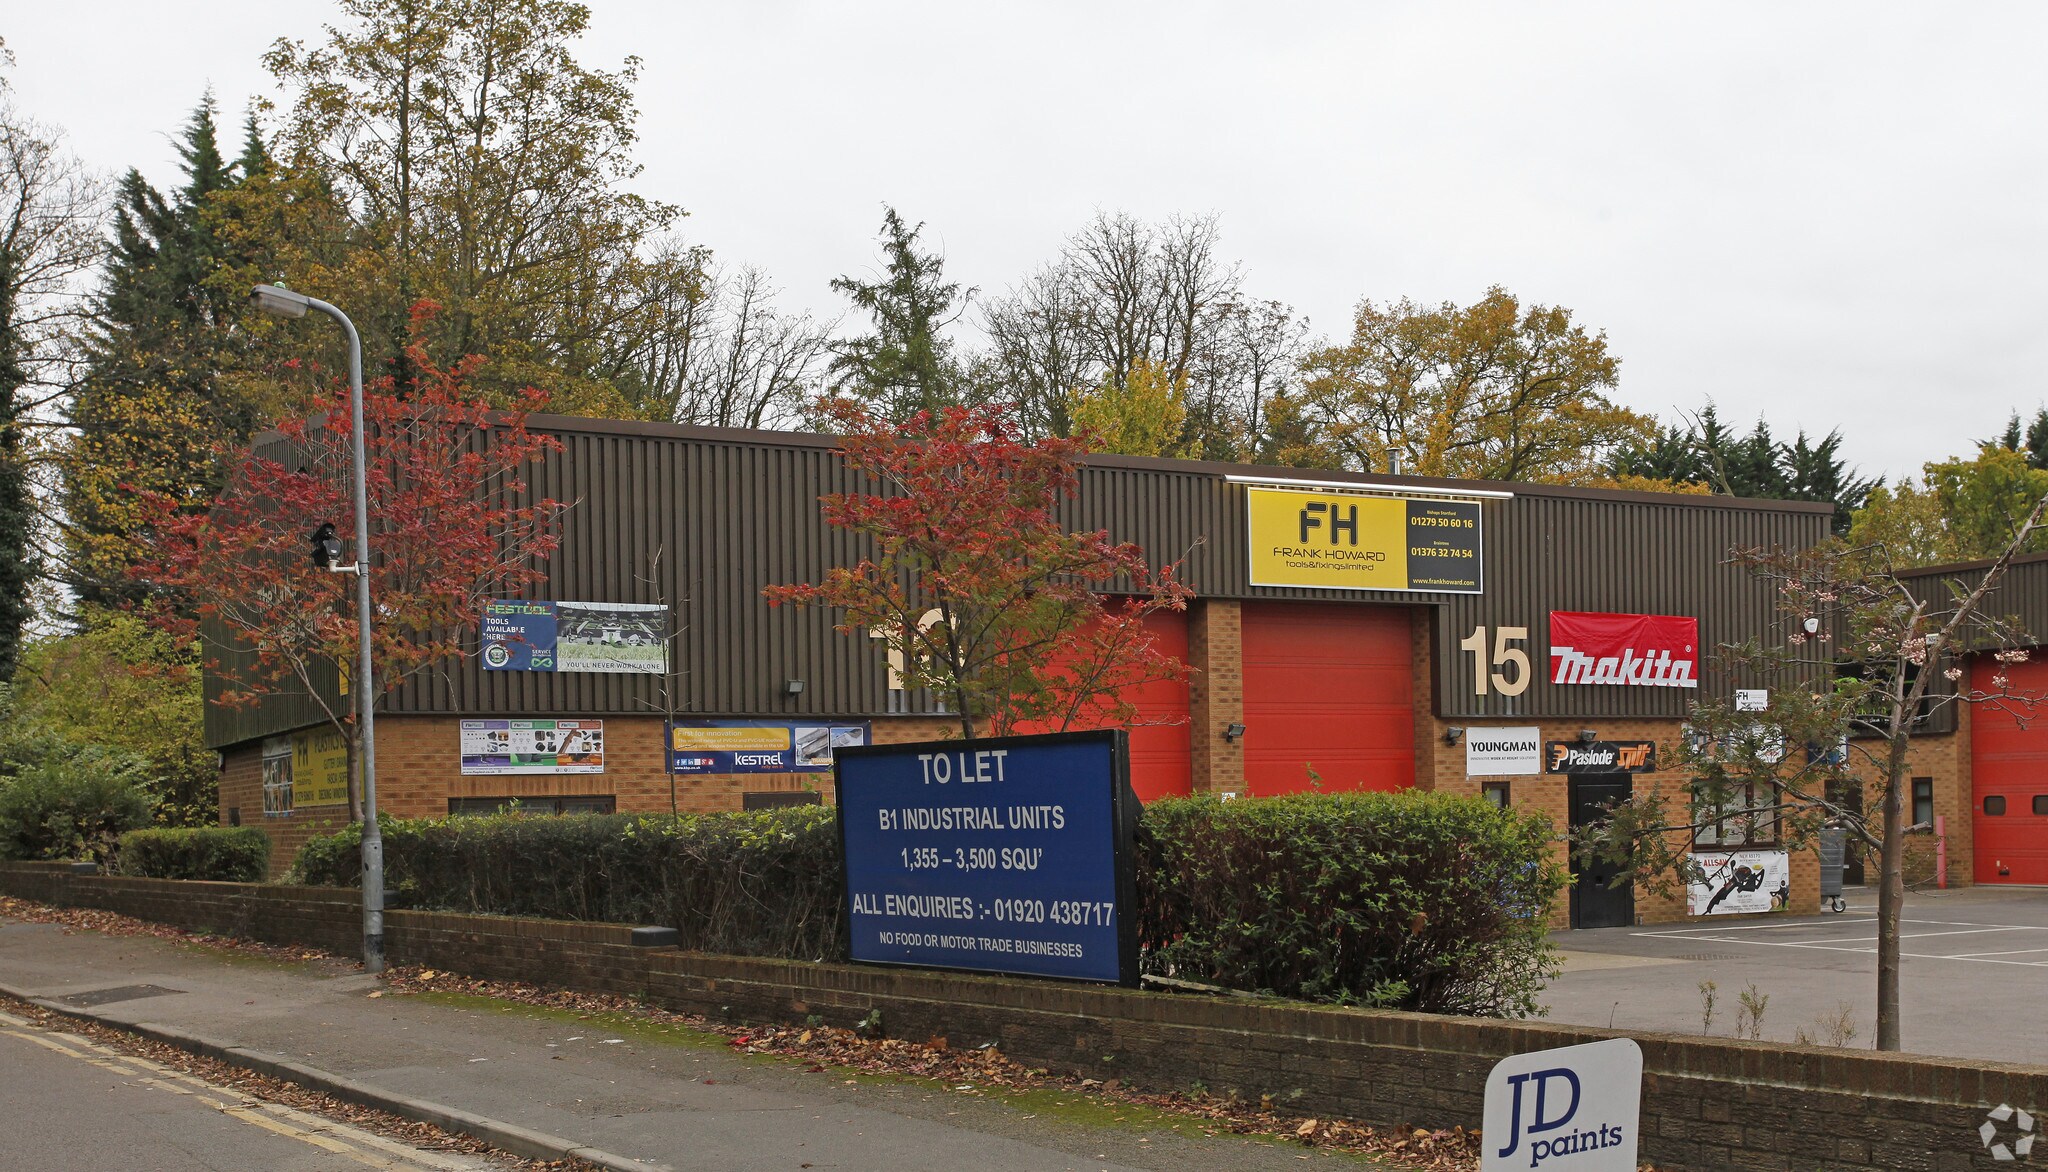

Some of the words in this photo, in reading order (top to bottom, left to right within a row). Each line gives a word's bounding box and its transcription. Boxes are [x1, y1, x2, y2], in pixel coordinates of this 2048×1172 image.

[1299, 501, 1359, 547] FH
[1411, 516, 1437, 527] 01279
[1438, 518, 1449, 528] 50
[1450, 518, 1461, 528] 60
[1463, 519, 1473, 528] 16
[1273, 546, 1322, 558] FRANK
[1325, 549, 1386, 562] HOWARD
[1411, 547, 1436, 558] 01376
[1438, 548, 1449, 558] 32
[1450, 548, 1461, 558] 74
[1462, 548, 1473, 558] 54
[1413, 577, 1474, 586] www.frankhoward.com
[486, 604, 552, 616] FESTOOL
[486, 626, 525, 634] AVAILABLE
[1462, 626, 1530, 696] 15
[1470, 742, 1536, 752] YOUNGMAN
[735, 752, 783, 766] KESTREL
[918, 753, 950, 784] TO
[959, 750, 1008, 783] LET
[1569, 750, 1613, 765] Paslode
[879, 809, 898, 830] B1
[902, 806, 1004, 830] INDUSTRIAL
[1008, 806, 1064, 830] UNITS
[902, 848, 938, 872] 1,355
[956, 848, 996, 872] 3,500
[853, 894, 882, 915] ALL
[886, 894, 974, 920] ENQUIRIES
[995, 899, 1044, 923] 01920
[1050, 901, 1114, 926] 438717
[880, 932, 894, 944] NO
[896, 932, 922, 947] FOOD
[924, 934, 938, 948] OR
[940, 935, 976, 950] MOTOR
[978, 938, 1012, 952] TRADE
[1015, 940, 1082, 958] BUSINESSES
[1498, 1068, 1580, 1158] JD
[1530, 1123, 1622, 1168] paints
